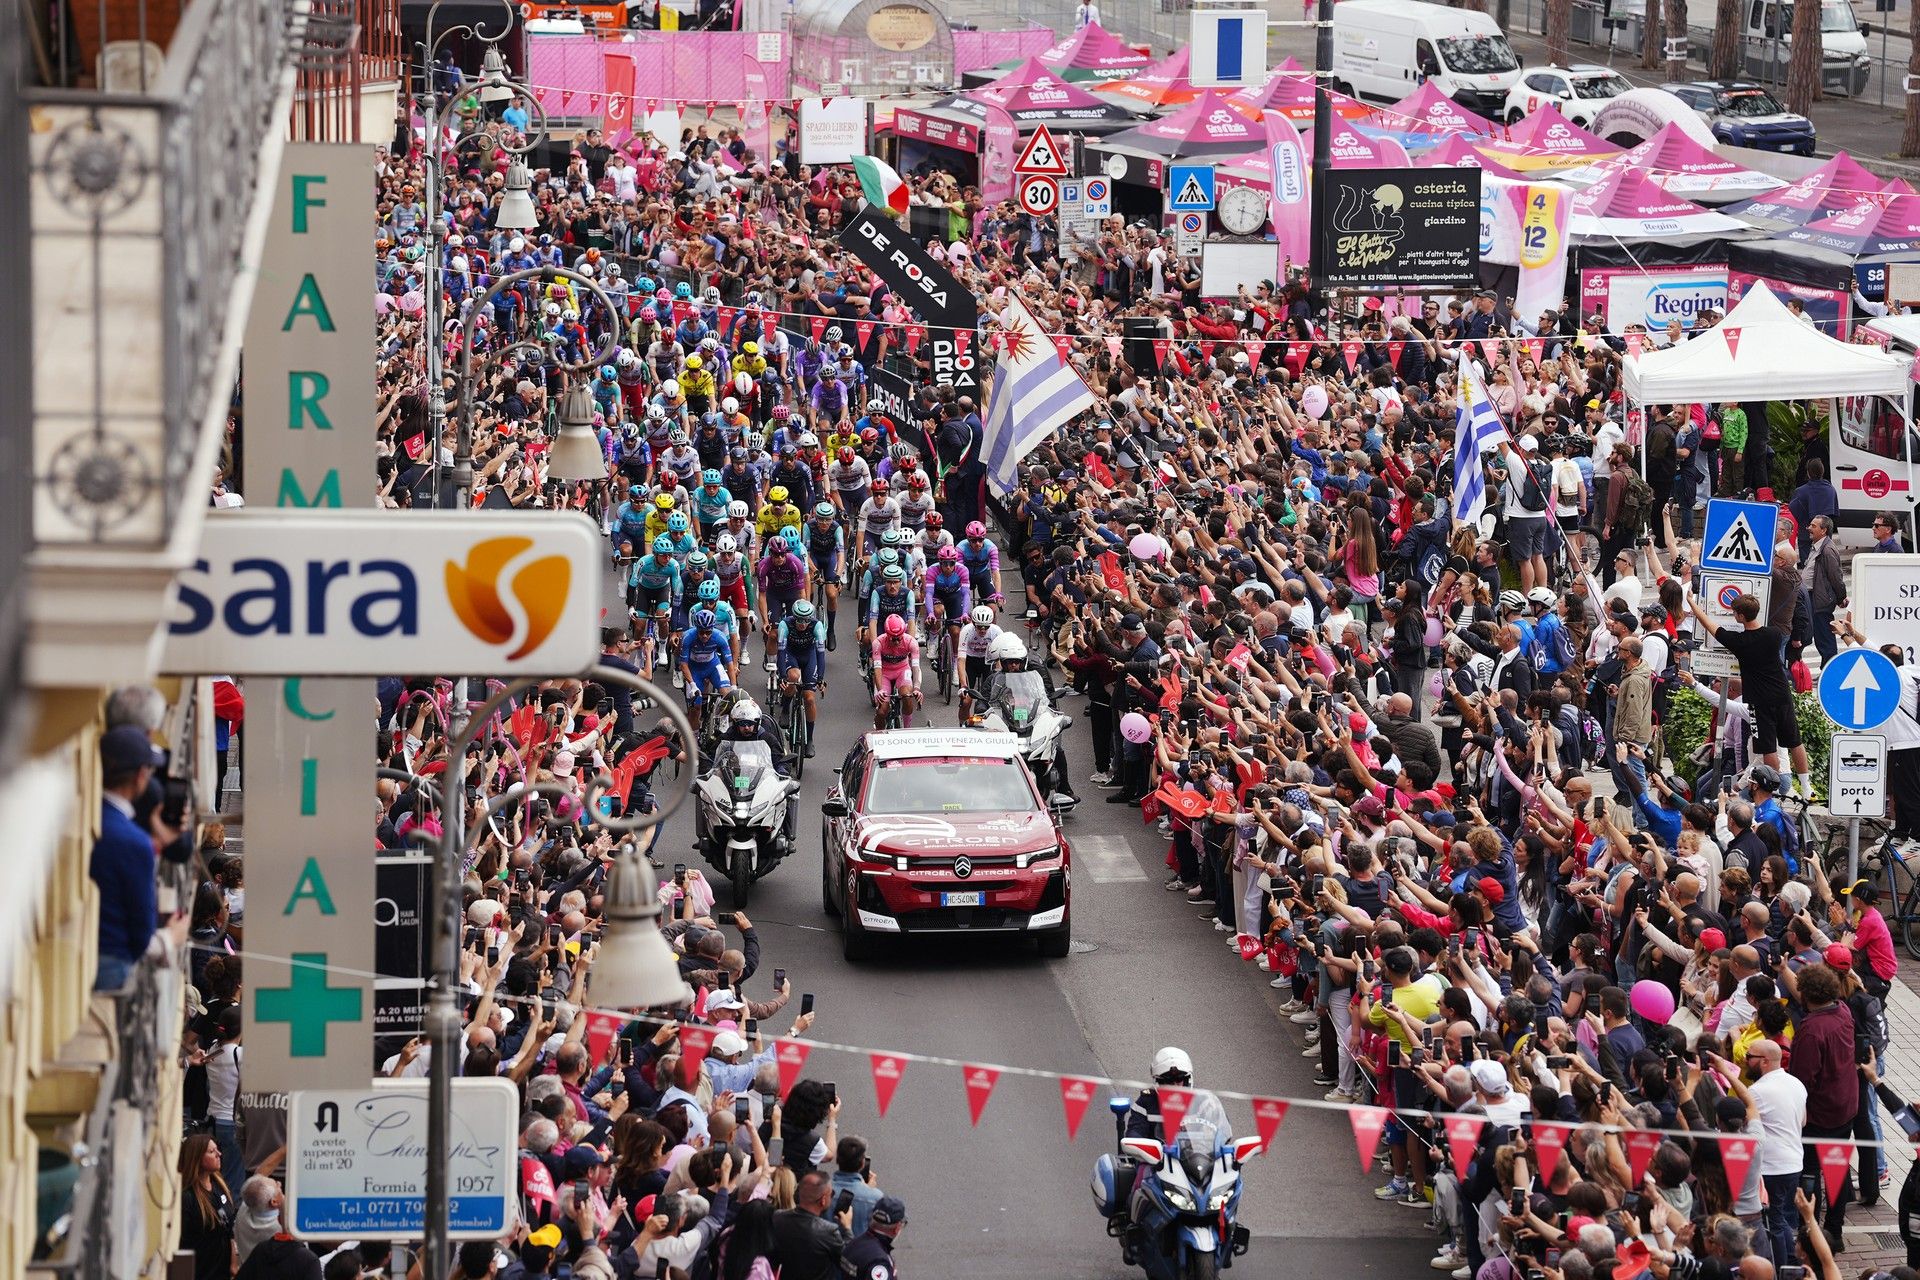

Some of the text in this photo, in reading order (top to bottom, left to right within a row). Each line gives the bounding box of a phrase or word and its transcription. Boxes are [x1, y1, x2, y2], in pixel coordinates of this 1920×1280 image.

[1093, 69, 1139, 77] KOMETA
[806, 122, 857, 132] SPAZIO LIBERO
[1682, 163, 1735, 172] #giroditalia
[1414, 181, 1467, 194] osteria
[1029, 186, 1051, 204] 30
[1410, 199, 1475, 209] cucina tipica
[1533, 194, 1546, 210] 4
[1638, 204, 1694, 214] #giroditalia
[1424, 215, 1466, 227] giardino
[1644, 221, 1678, 231] Regina
[1524, 225, 1547, 248] 12
[1358, 233, 1386, 254] Gatto
[1878, 242, 1909, 251] sara
[1425, 250, 1444, 258] d'altri
[1446, 251, 1463, 259] tempi
[858, 221, 947, 309] DE ROSA
[1398, 259, 1409, 267] per
[1418, 258, 1450, 267] buongustai
[1452, 258, 1470, 266] d'oggi
[1868, 269, 1885, 281] sa
[1654, 292, 1724, 316] Regina
[935, 372, 976, 387] SA
[277, 175, 343, 915] FARMCIA
[1899, 584, 1920, 598] SP
[875, 738, 885, 746] IO
[887, 738, 916, 746] SONO
[945, 737, 983, 745] VENEZIA
[985, 737, 1015, 745] GIULIA
[1841, 785, 1874, 796] porto
[974, 868, 1017, 876] CITROËN
[400, 910, 414, 918] HAIR
[1032, 914, 1060, 923] CITROËN
[400, 918, 420, 926] SALON
[864, 916, 894, 924] CITROËN
[378, 1006, 431, 1015] A 20 METR
[312, 1138, 346, 1147] avete
[303, 1149, 355, 1159] superato
[304, 1158, 353, 1170] di mt 20
[363, 1175, 495, 1193] Formia 1957
[339, 1201, 364, 1214] Tel.
[368, 1200, 400, 1214] 0771
[304, 1217, 492, 1231] (parcheggio alla fine di via ettembre)
